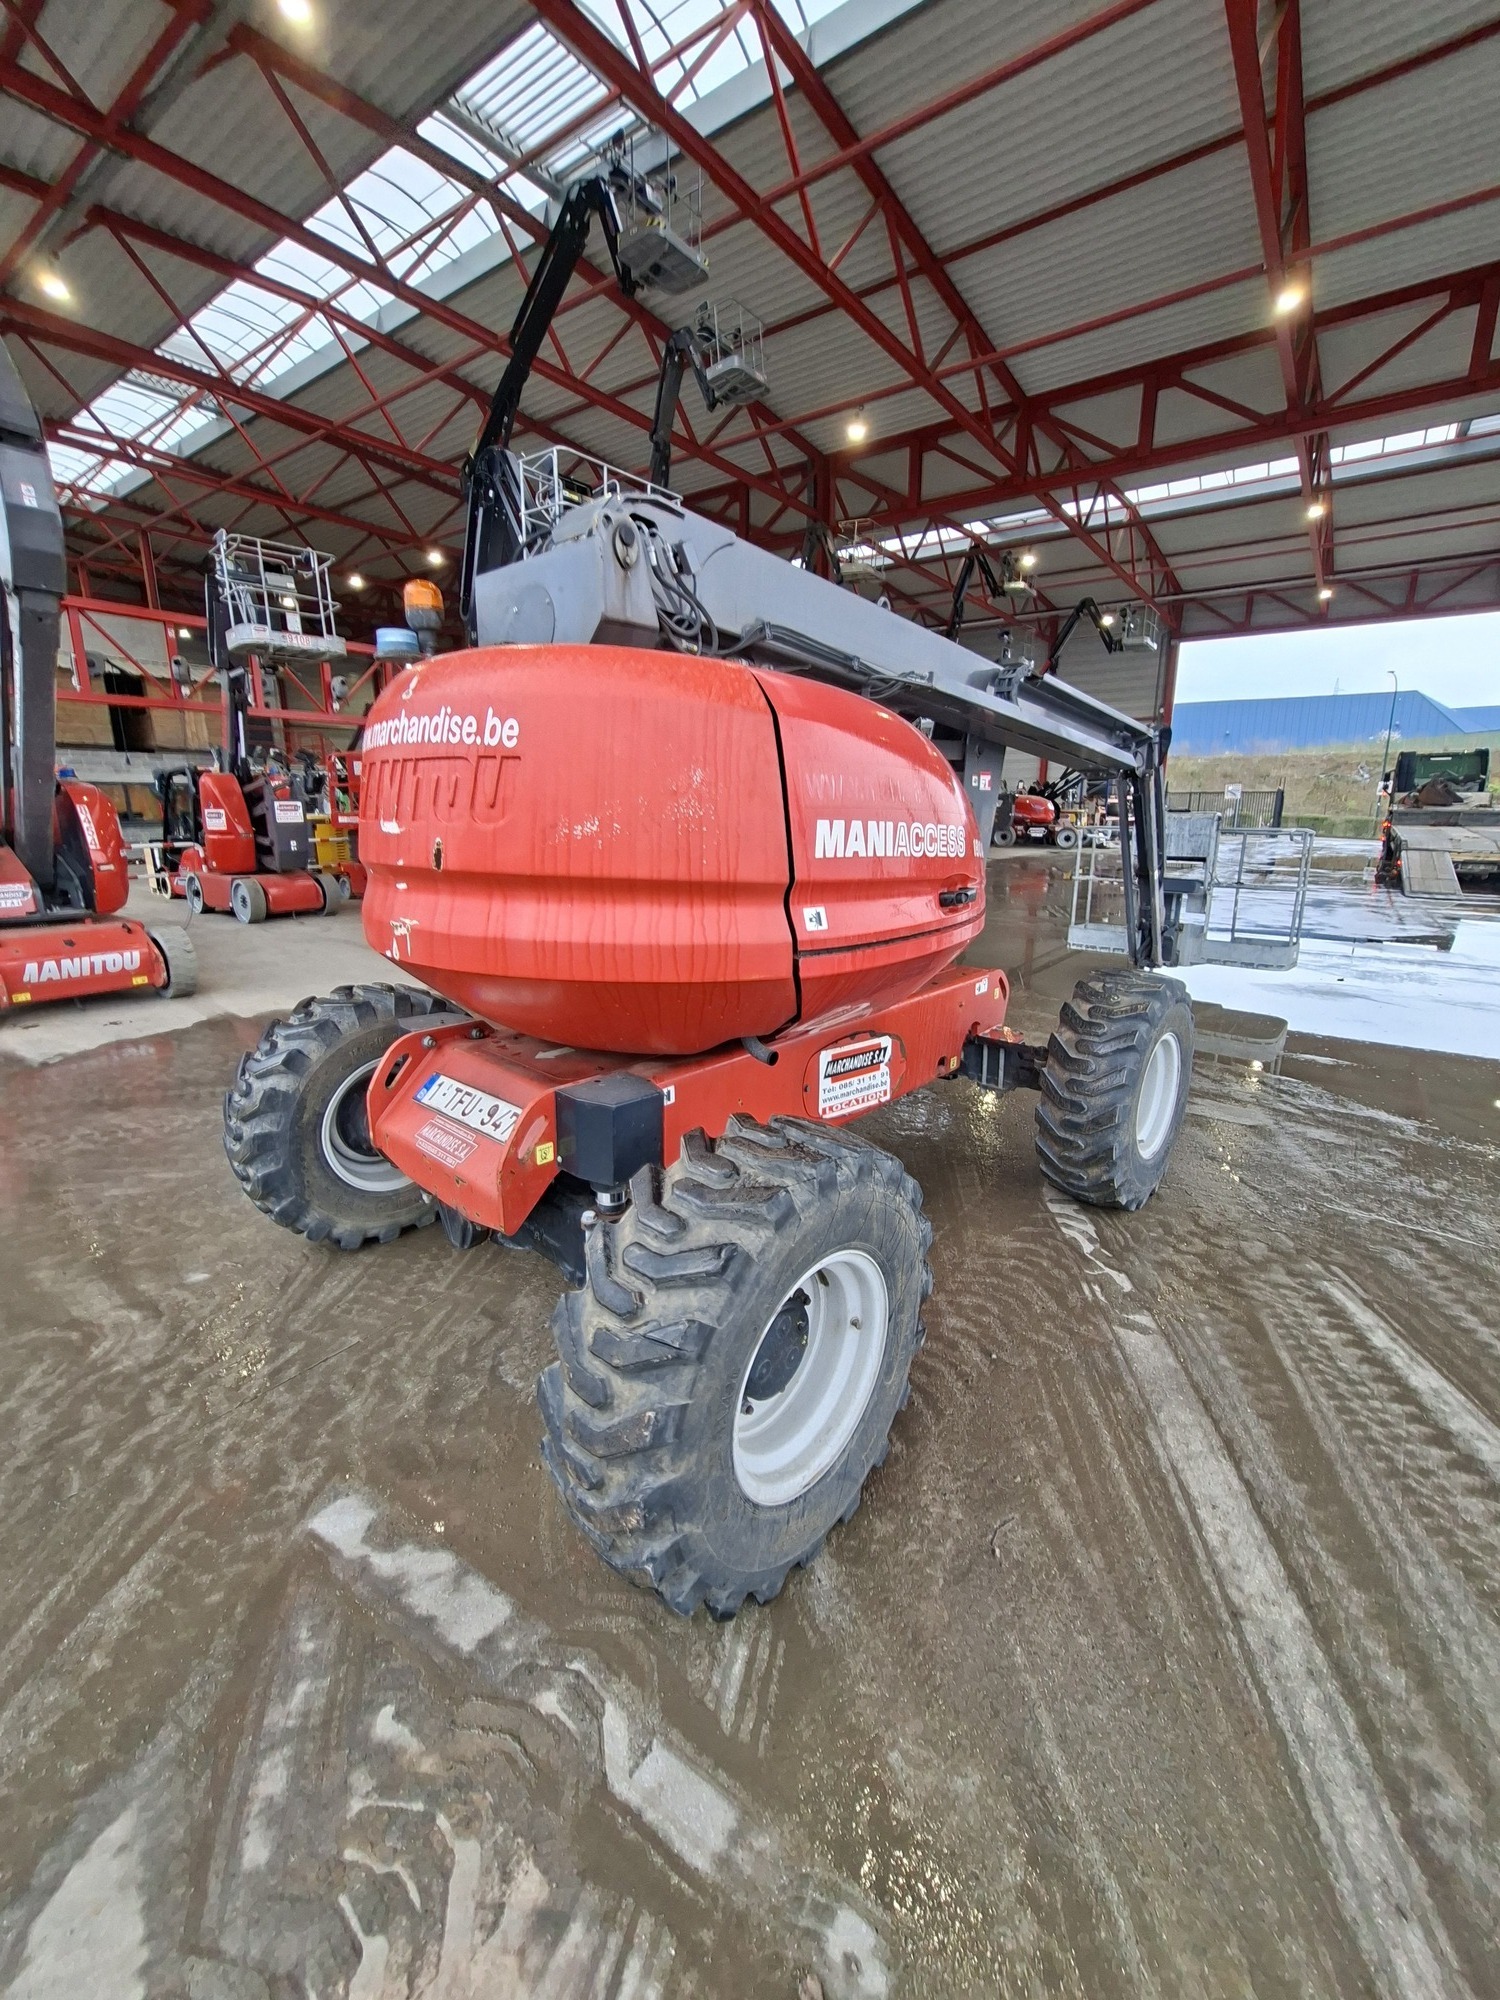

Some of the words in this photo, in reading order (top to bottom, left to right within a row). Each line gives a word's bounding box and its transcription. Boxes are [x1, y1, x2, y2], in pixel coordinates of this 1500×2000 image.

[814, 819, 966, 859] MANIACCESS
[825, 1052, 873, 1076] MARCHANDISE
[822, 1079, 888, 1104] www.marchandise.be
[825, 1091, 884, 1114] LOCATION
